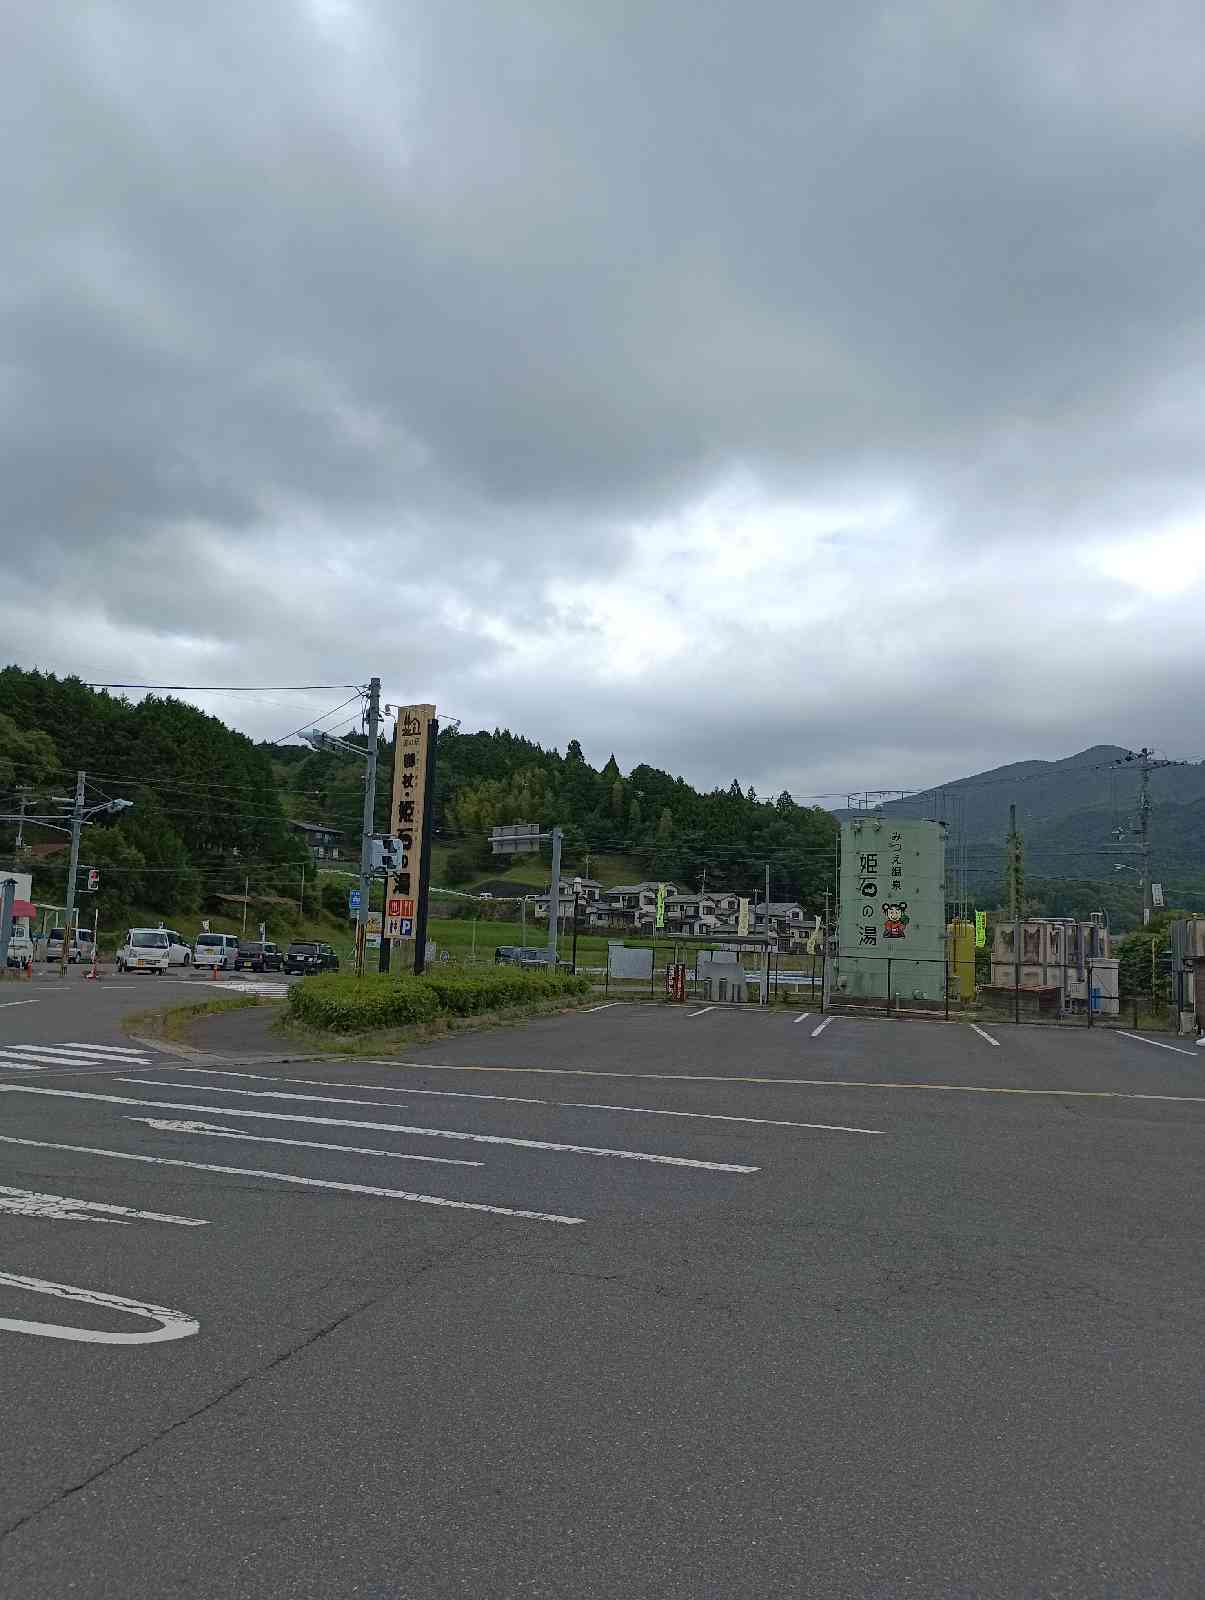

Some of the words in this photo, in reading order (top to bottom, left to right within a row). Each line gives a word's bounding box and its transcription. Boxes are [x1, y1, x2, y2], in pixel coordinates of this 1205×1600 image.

[889, 832, 902, 891] みつえ温泉
